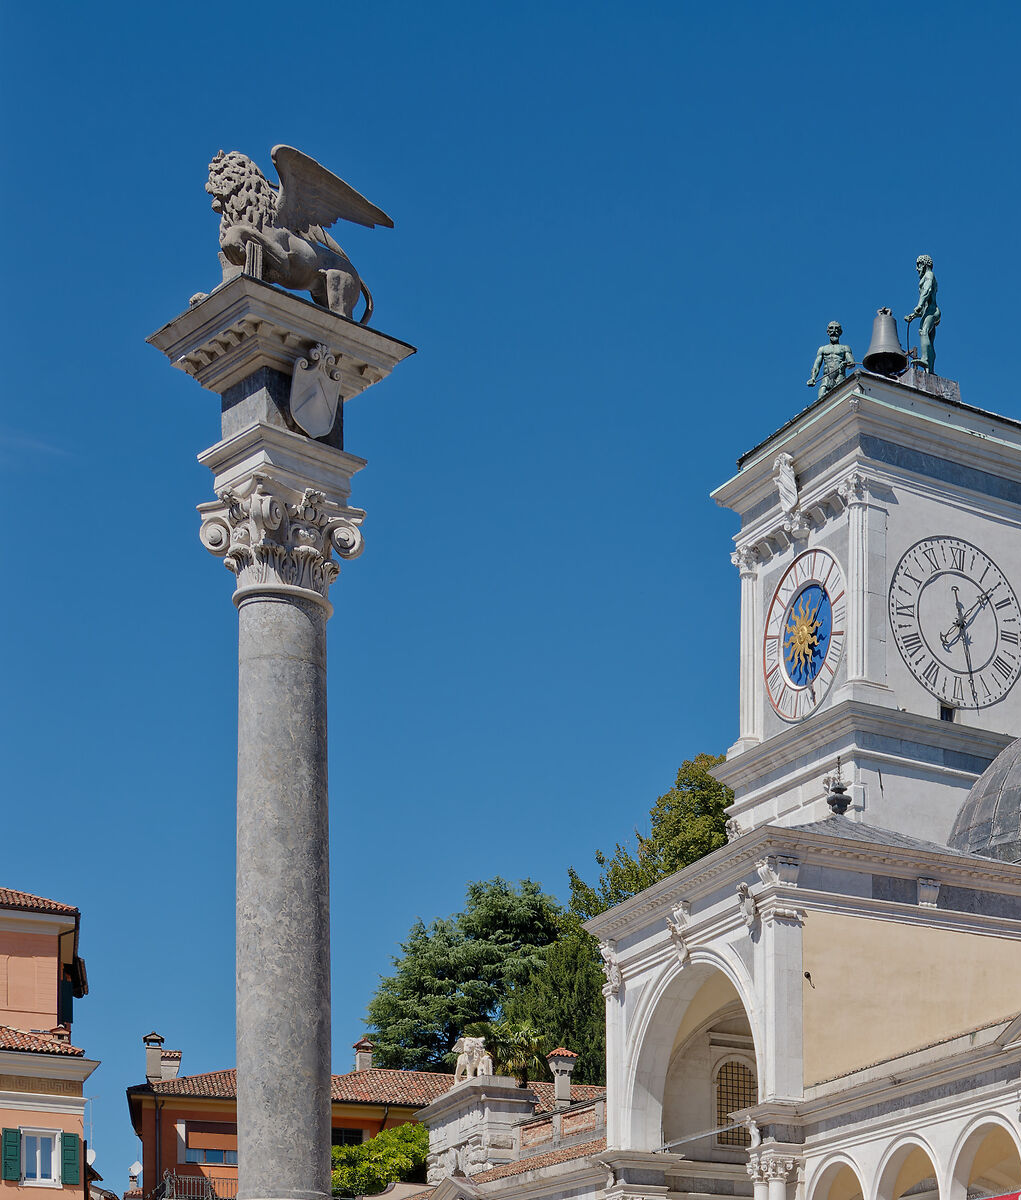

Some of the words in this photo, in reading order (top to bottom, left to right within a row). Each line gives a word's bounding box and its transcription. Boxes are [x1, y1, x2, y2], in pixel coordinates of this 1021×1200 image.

[923, 548, 941, 574] XI
[950, 546, 966, 572] XII
[903, 567, 923, 590] X
[896, 598, 915, 619] IX
[994, 597, 1012, 610] II
[901, 632, 924, 658] VIII
[1000, 630, 1019, 646] III
[922, 659, 940, 688] VII
